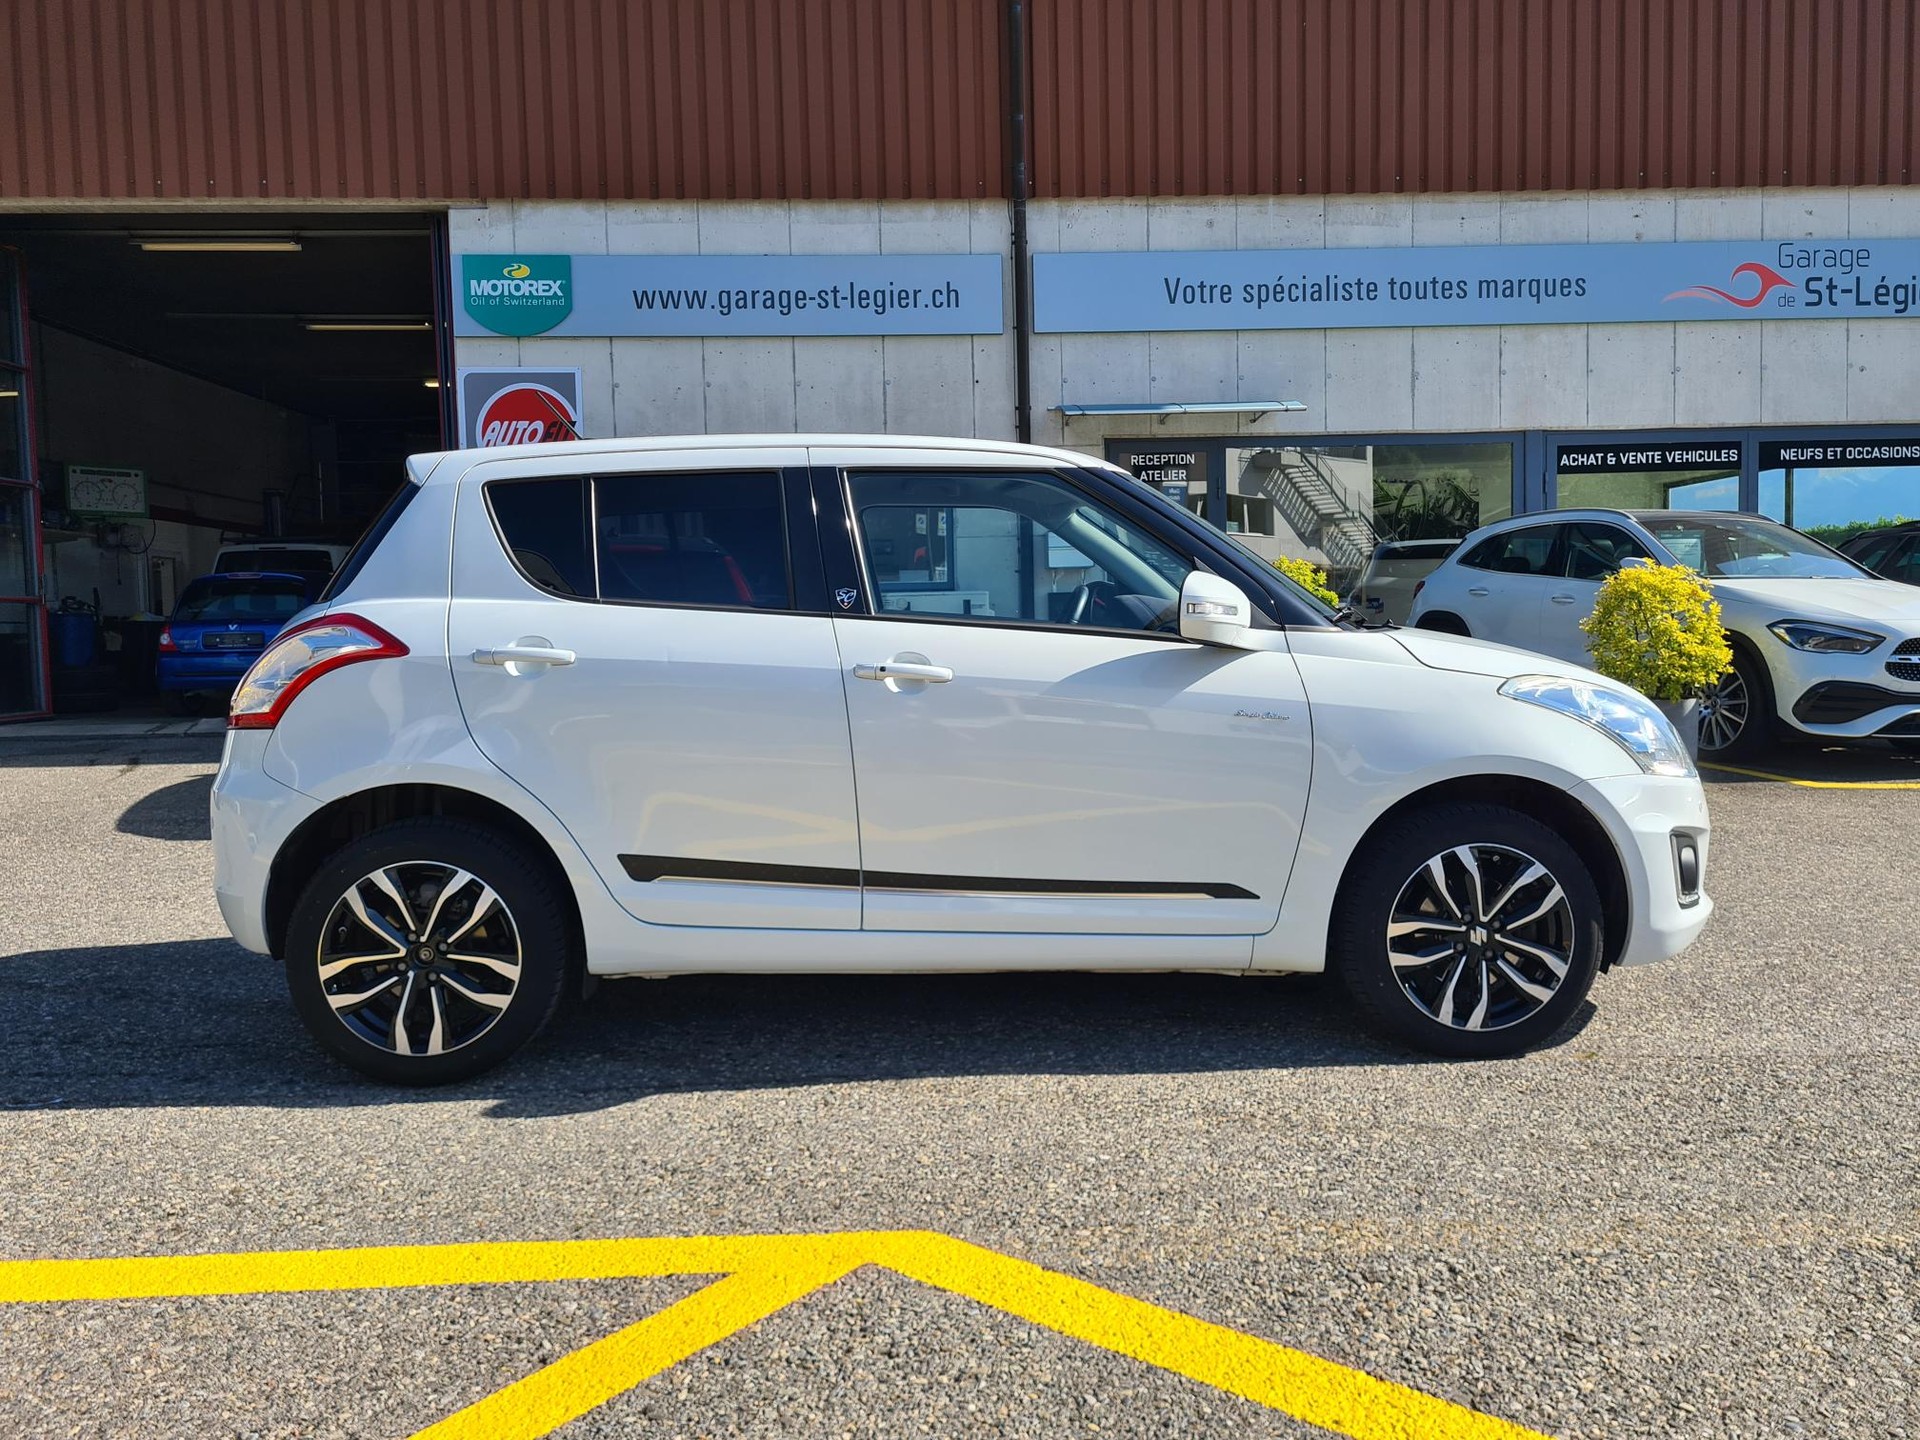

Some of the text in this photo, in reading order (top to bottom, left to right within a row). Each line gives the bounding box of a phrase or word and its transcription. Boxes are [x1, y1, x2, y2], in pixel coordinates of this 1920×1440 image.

[1778, 242, 1871, 275] Garage
[470, 279, 564, 296] MOTOREX
[1163, 274, 1587, 309] Votre spécialiste toutes marques
[1777, 275, 1920, 314] de St-Légi
[471, 296, 565, 306] Oil of Switzerland
[632, 281, 960, 316] www.garage-st-legier.ch
[1130, 453, 1196, 466] RECEPTION
[1560, 449, 1738, 466] ACHAT & VENTE VEHICULES
[1780, 446, 1920, 460] NEUFS ET OCCASIONS
[1140, 469, 1187, 481] ATELIER
